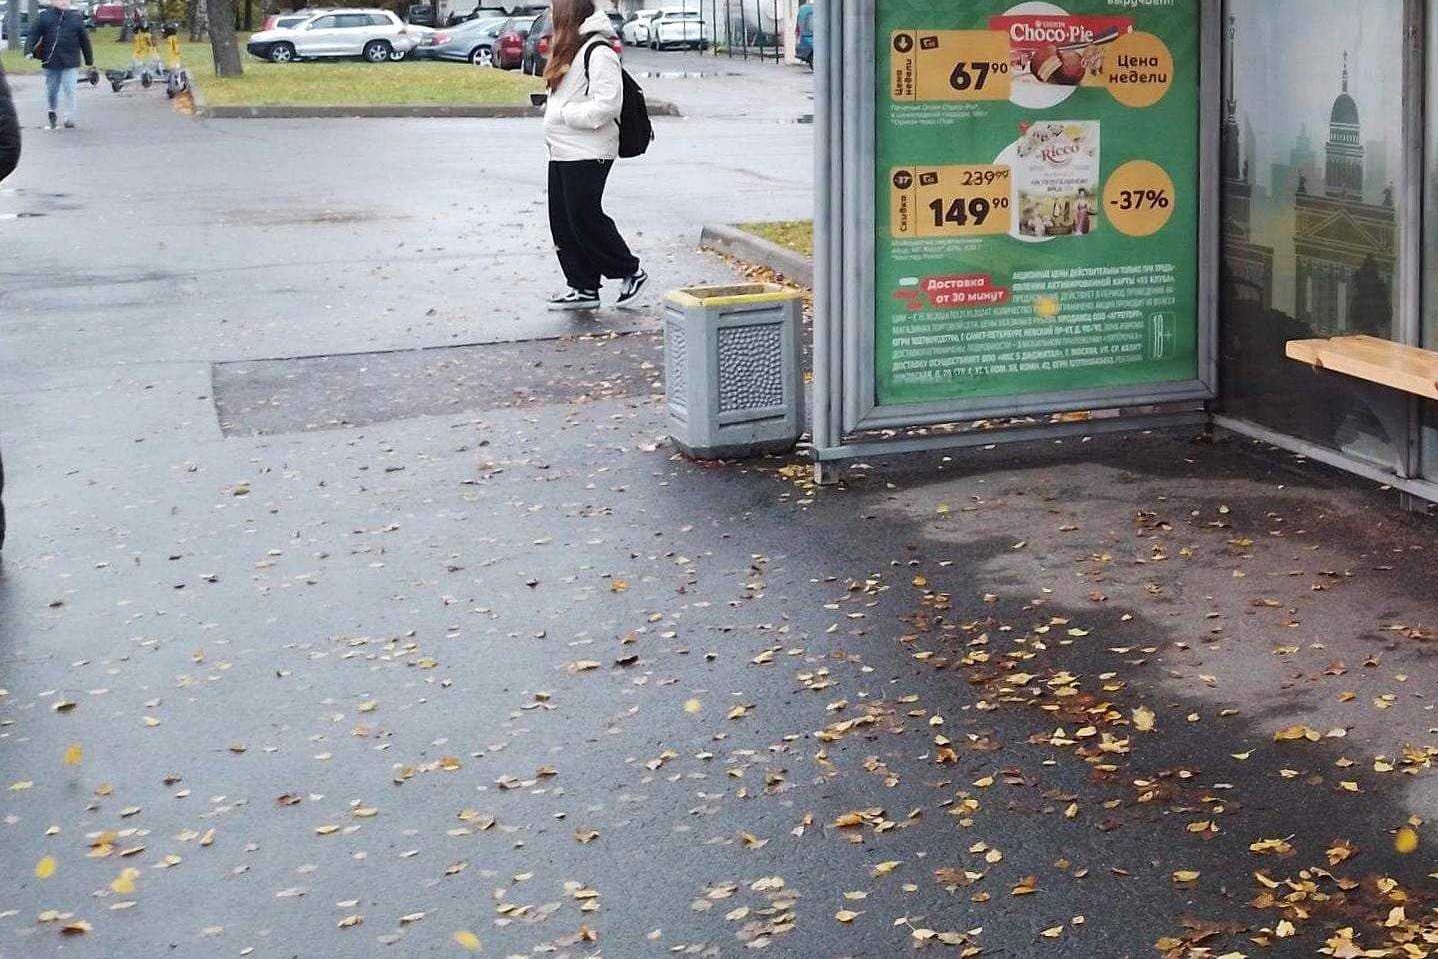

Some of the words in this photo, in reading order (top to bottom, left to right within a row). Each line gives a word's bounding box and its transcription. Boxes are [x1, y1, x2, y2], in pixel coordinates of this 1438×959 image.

[1117, 54, 1159, 69] Цена
[895, 70, 904, 97] Цена
[904, 58, 913, 96] недели
[1109, 70, 1168, 83] недели
[1110, 189, 1169, 210] -37%
[899, 195, 908, 232] Скидка
[929, 197, 990, 227] 149
[992, 197, 1009, 209] 90
[927, 278, 985, 291] Доставка
[936, 294, 949, 303] от
[951, 293, 965, 303] 30
[967, 290, 1004, 303] минут
